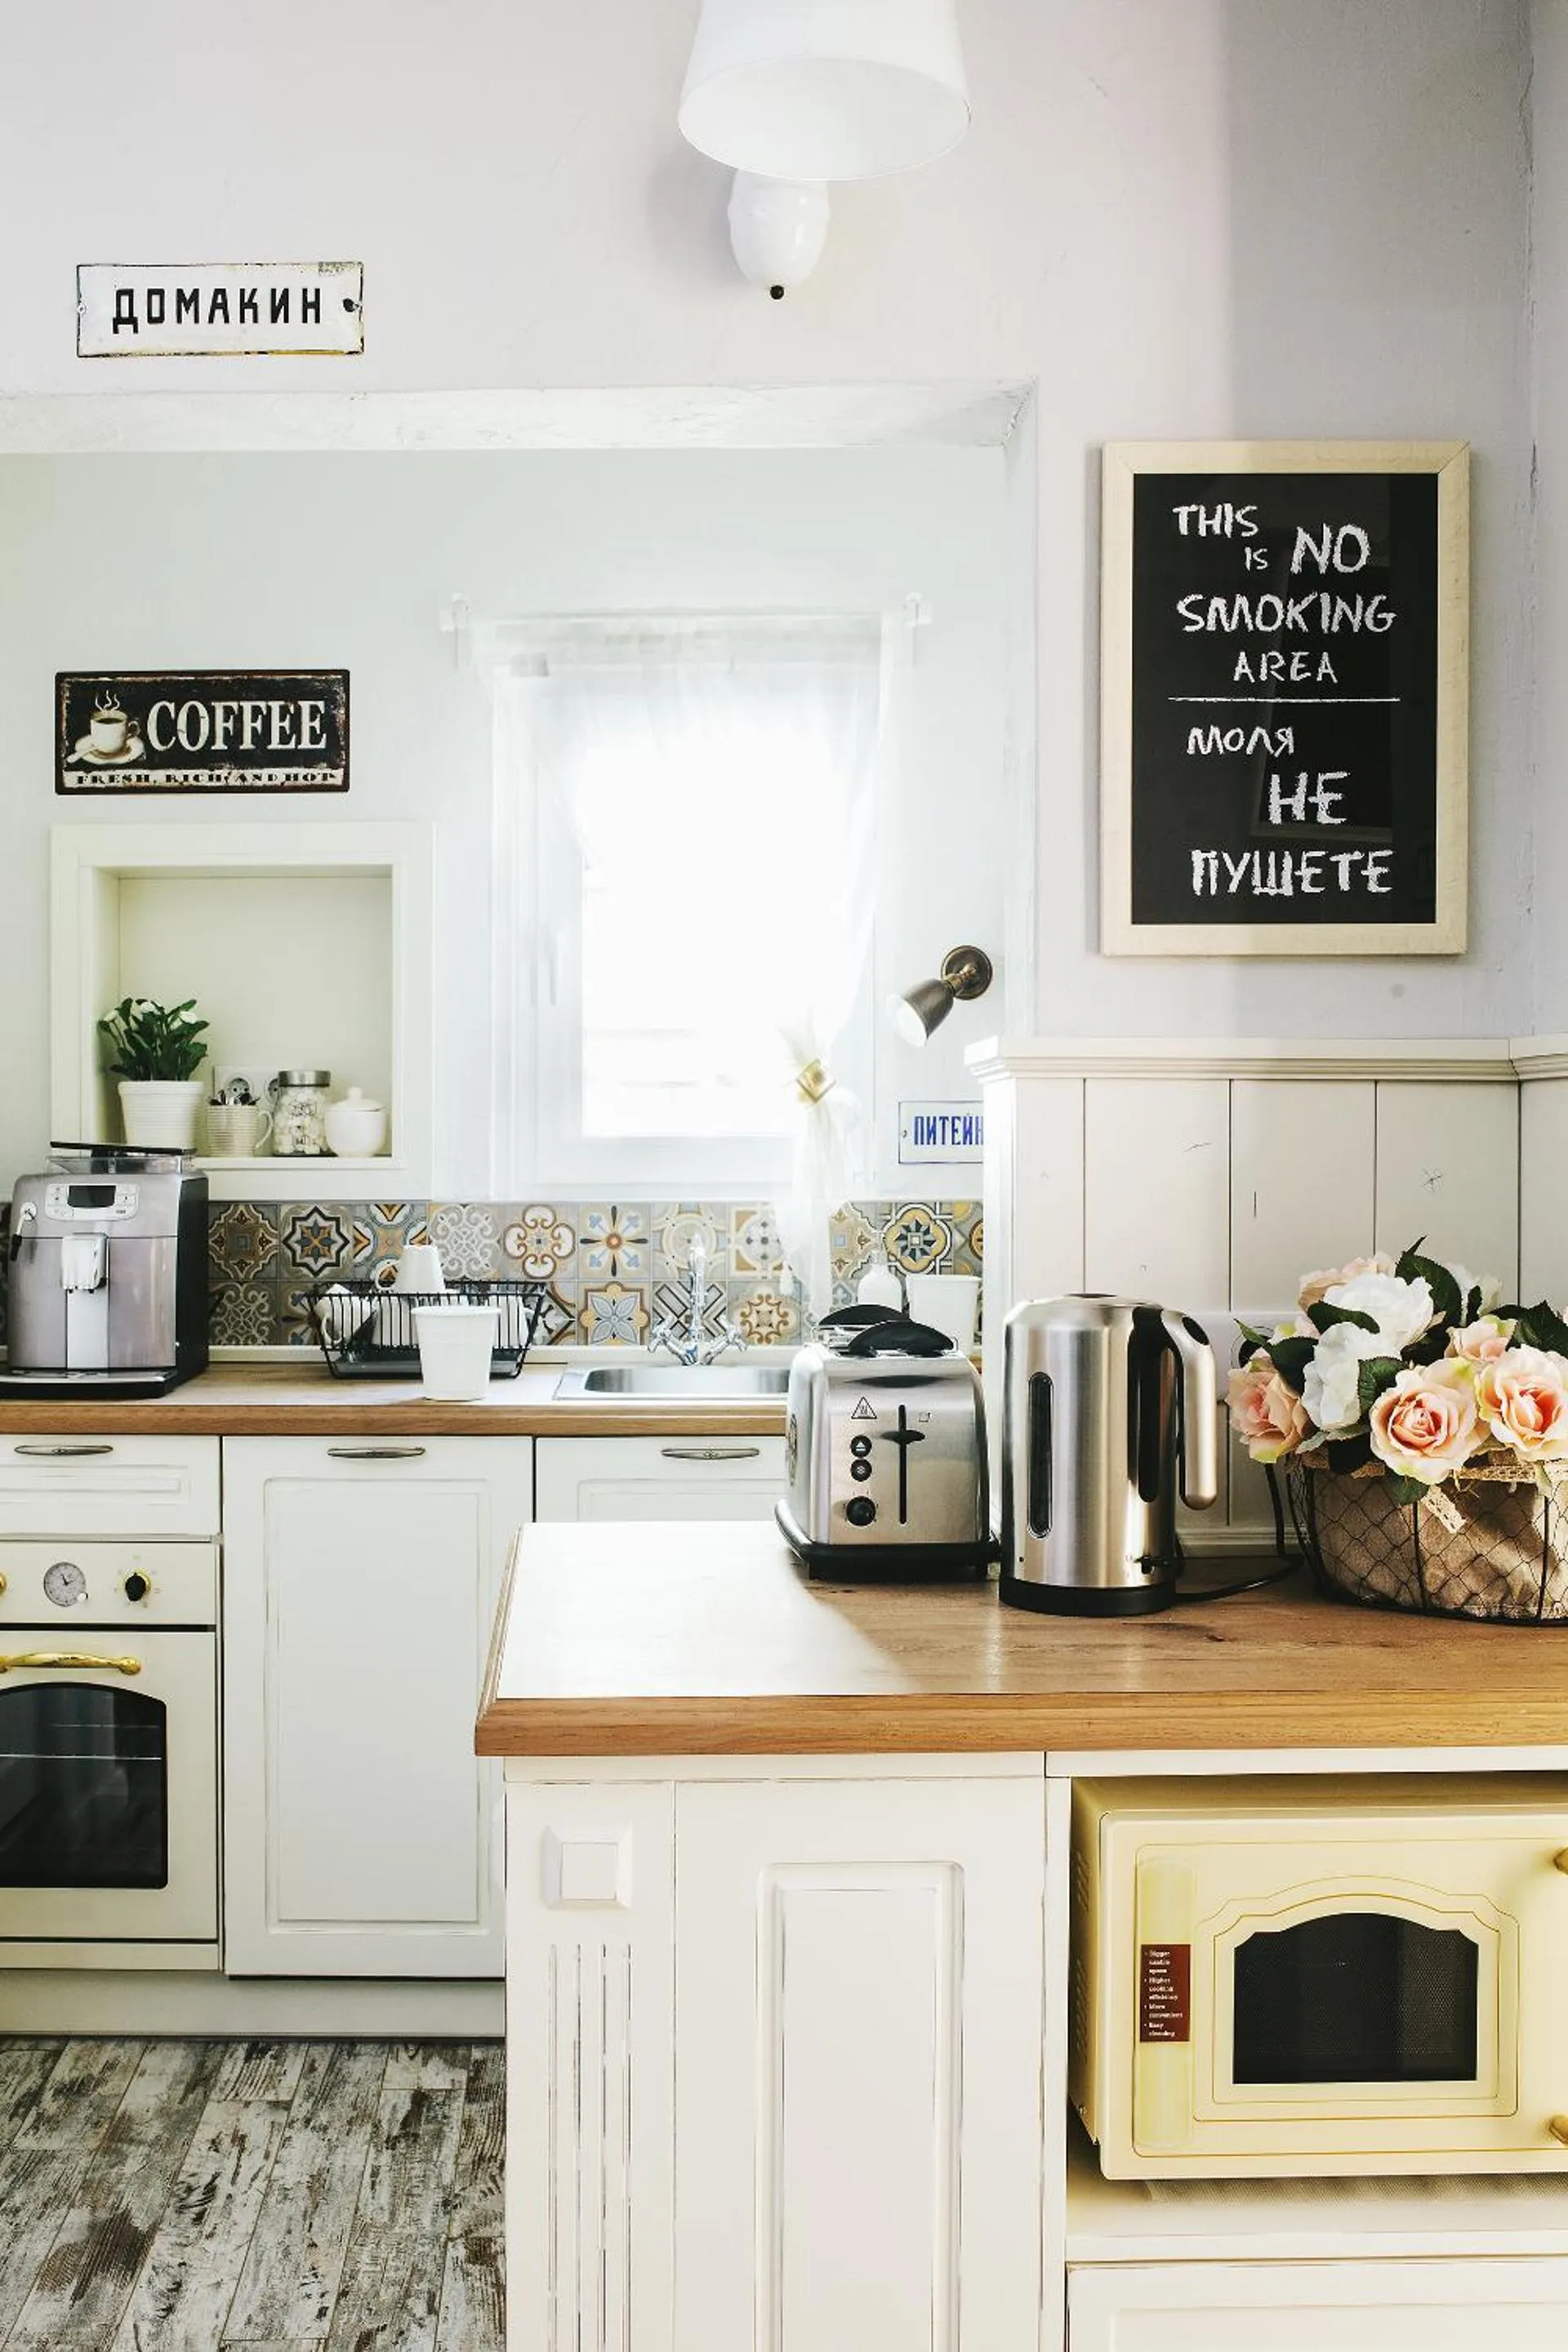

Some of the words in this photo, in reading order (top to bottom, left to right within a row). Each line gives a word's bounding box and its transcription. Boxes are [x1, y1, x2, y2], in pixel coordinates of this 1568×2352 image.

[112, 287, 321, 334] ДОМАКИН
[1172, 502, 1258, 539] THIS
[1244, 546, 1268, 571] IS
[1290, 523, 1371, 575] NO
[1176, 591, 1397, 634] SMOKING
[1233, 651, 1338, 684] AREA
[146, 700, 327, 752] COFFEE
[1267, 771, 1349, 826] НЕ
[1191, 849, 1393, 897] ПУШЕТЕ
